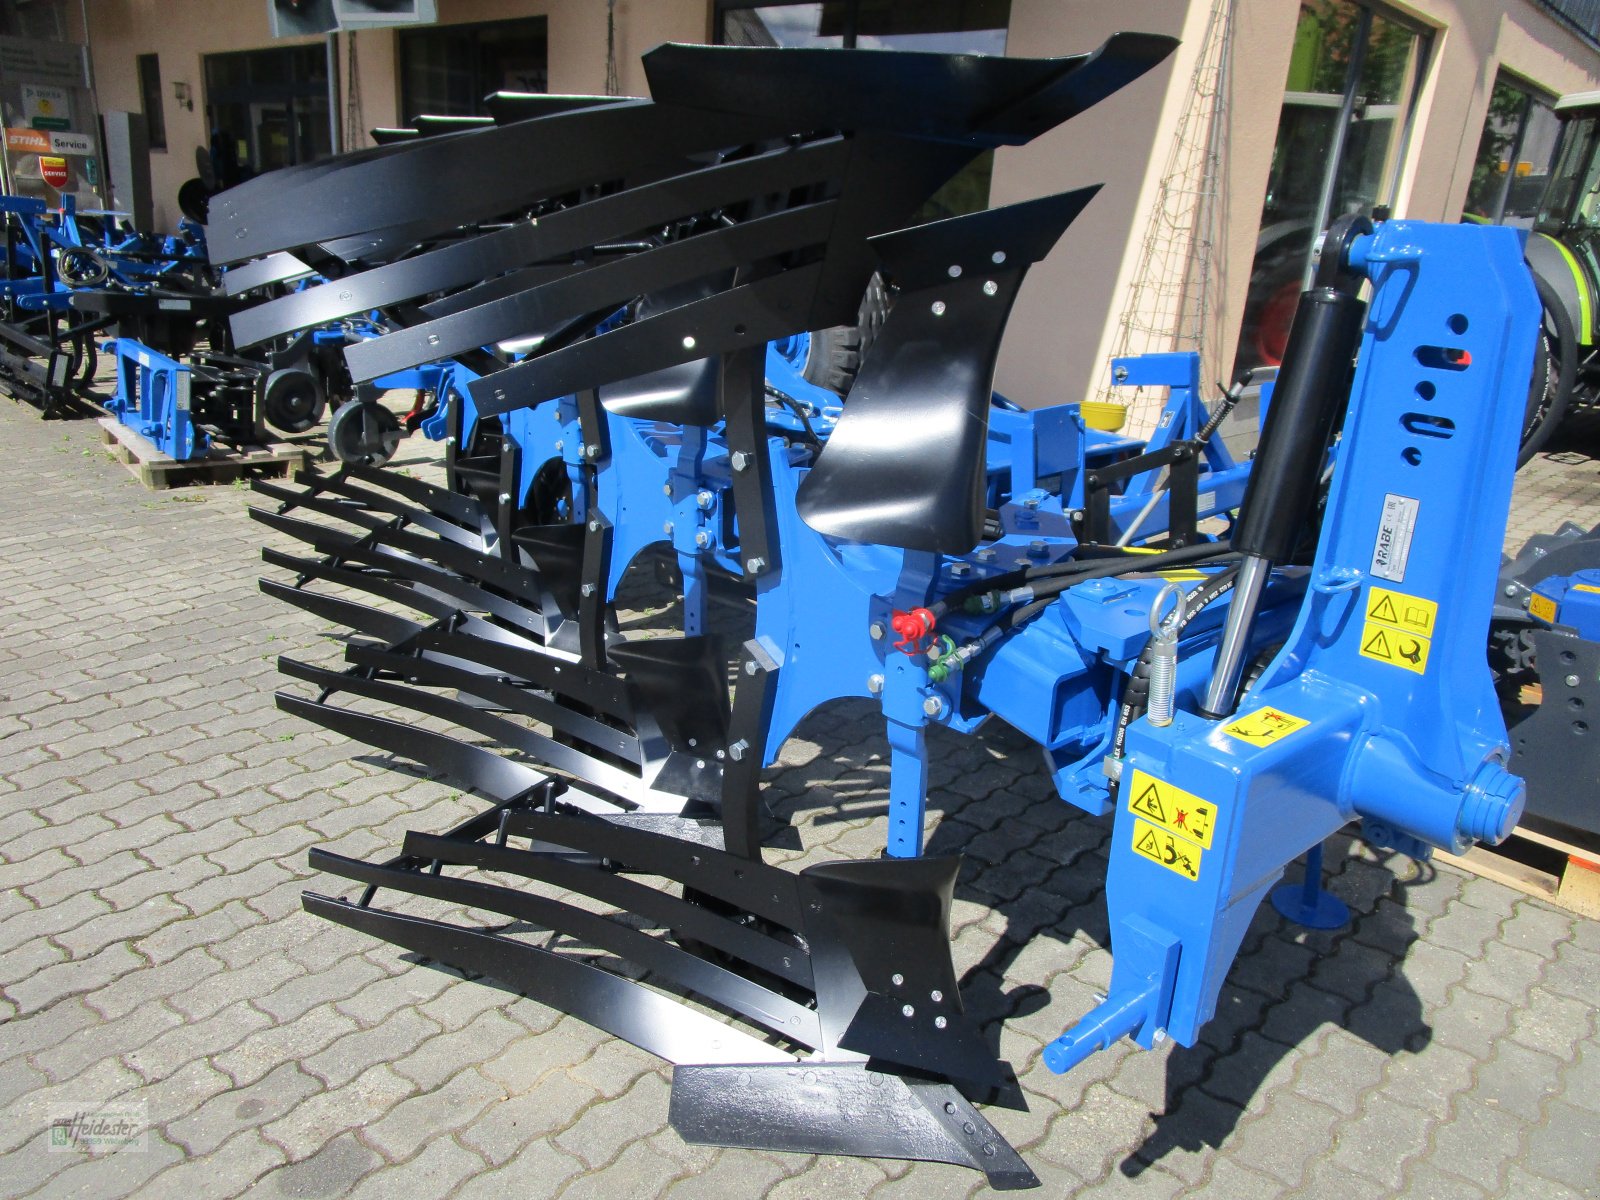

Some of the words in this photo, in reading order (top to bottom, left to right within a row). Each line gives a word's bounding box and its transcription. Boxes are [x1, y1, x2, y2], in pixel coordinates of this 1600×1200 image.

[10, 135, 47, 147] STIHL
[54, 138, 87, 149] Service
[1378, 525, 1393, 559] RABE
[1197, 603, 1204, 611] WP
[1121, 716, 1128, 726] EN
